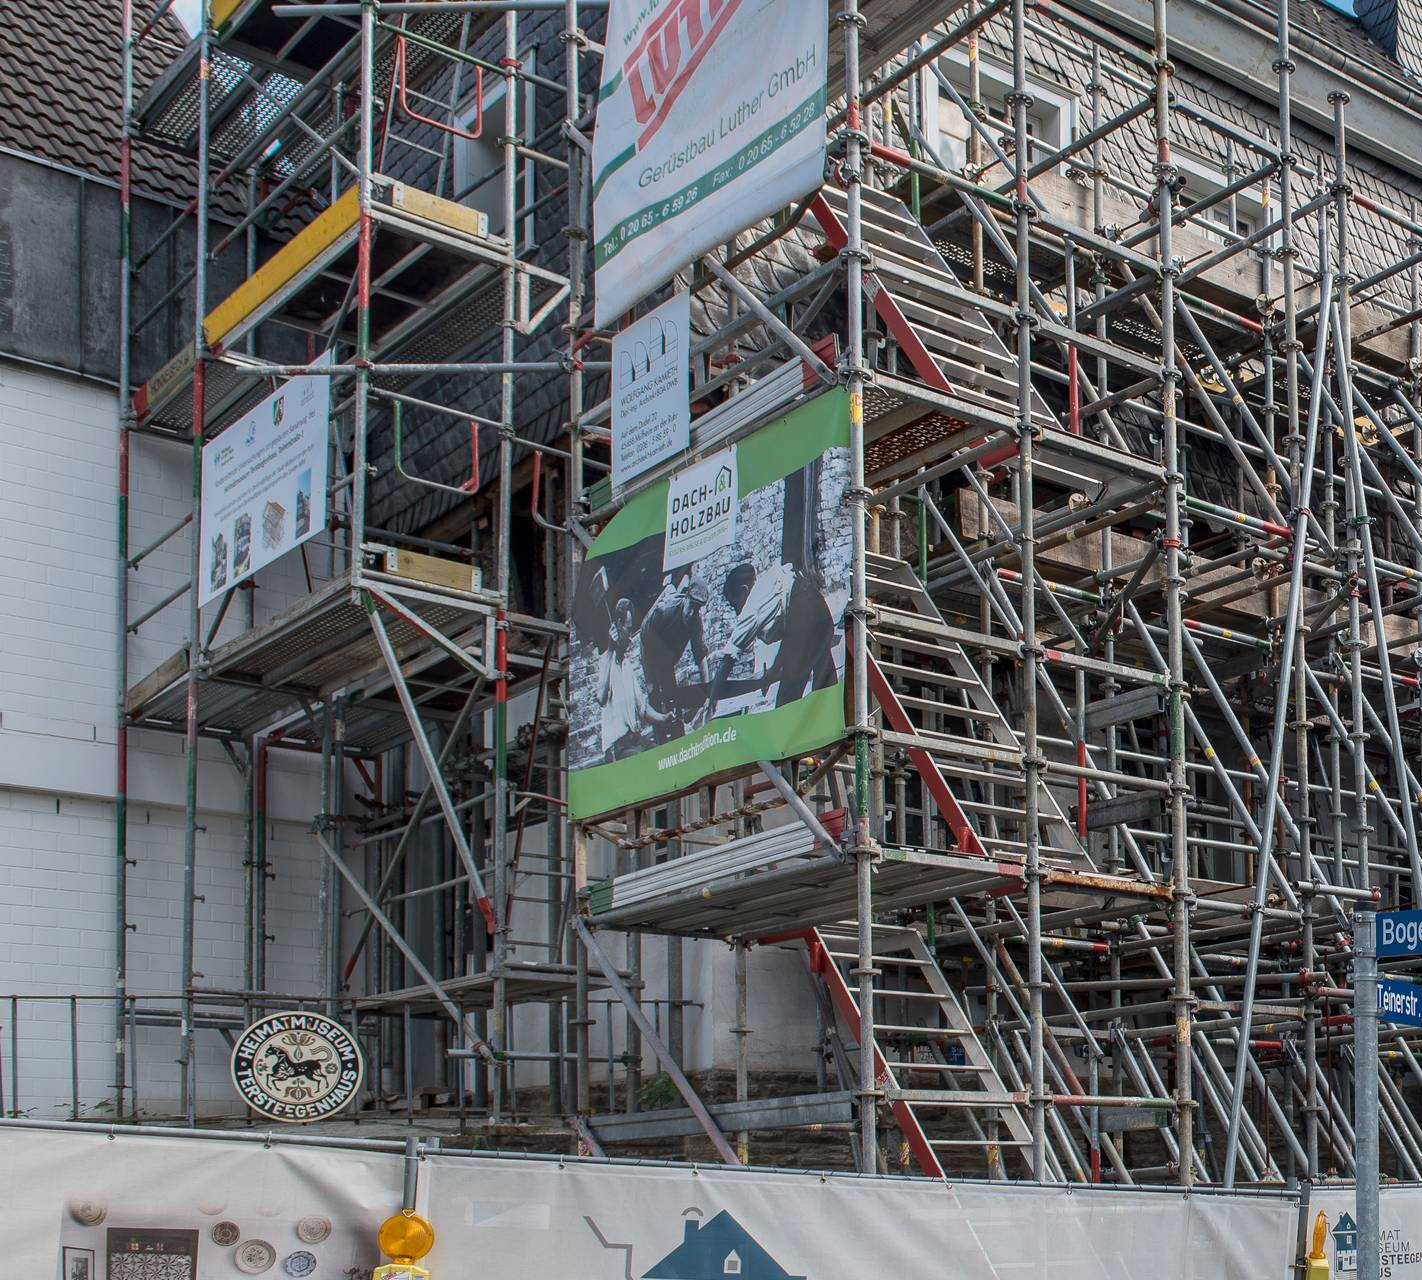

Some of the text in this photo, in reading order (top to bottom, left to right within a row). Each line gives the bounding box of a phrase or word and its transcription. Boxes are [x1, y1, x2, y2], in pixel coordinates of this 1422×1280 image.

[638, 43, 816, 188] Gerüstbau Luther GmbH
[603, 236, 619, 257] Tel.:
[620, 225, 626, 236] 0
[627, 217, 640, 233] 20
[641, 209, 654, 228] 65
[662, 202, 669, 217] 6
[671, 195, 684, 213] 59
[712, 168, 733, 188] Fax:
[739, 156, 745, 171] 0
[747, 145, 760, 165] 20
[761, 135, 773, 156] 65
[780, 124, 787, 139] 6
[789, 113, 801, 133] 52
[803, 102, 815, 122] 28
[670, 496, 731, 539] HOLZBAU
[672, 484, 713, 515] DACH-
[238, 1016, 356, 1061] HEIMATMUSEUM
[237, 1068, 357, 1118] TERSTEEGENHAUS
[1379, 1241, 1410, 1254] SEUM
[1380, 1229, 1401, 1241] MAT
